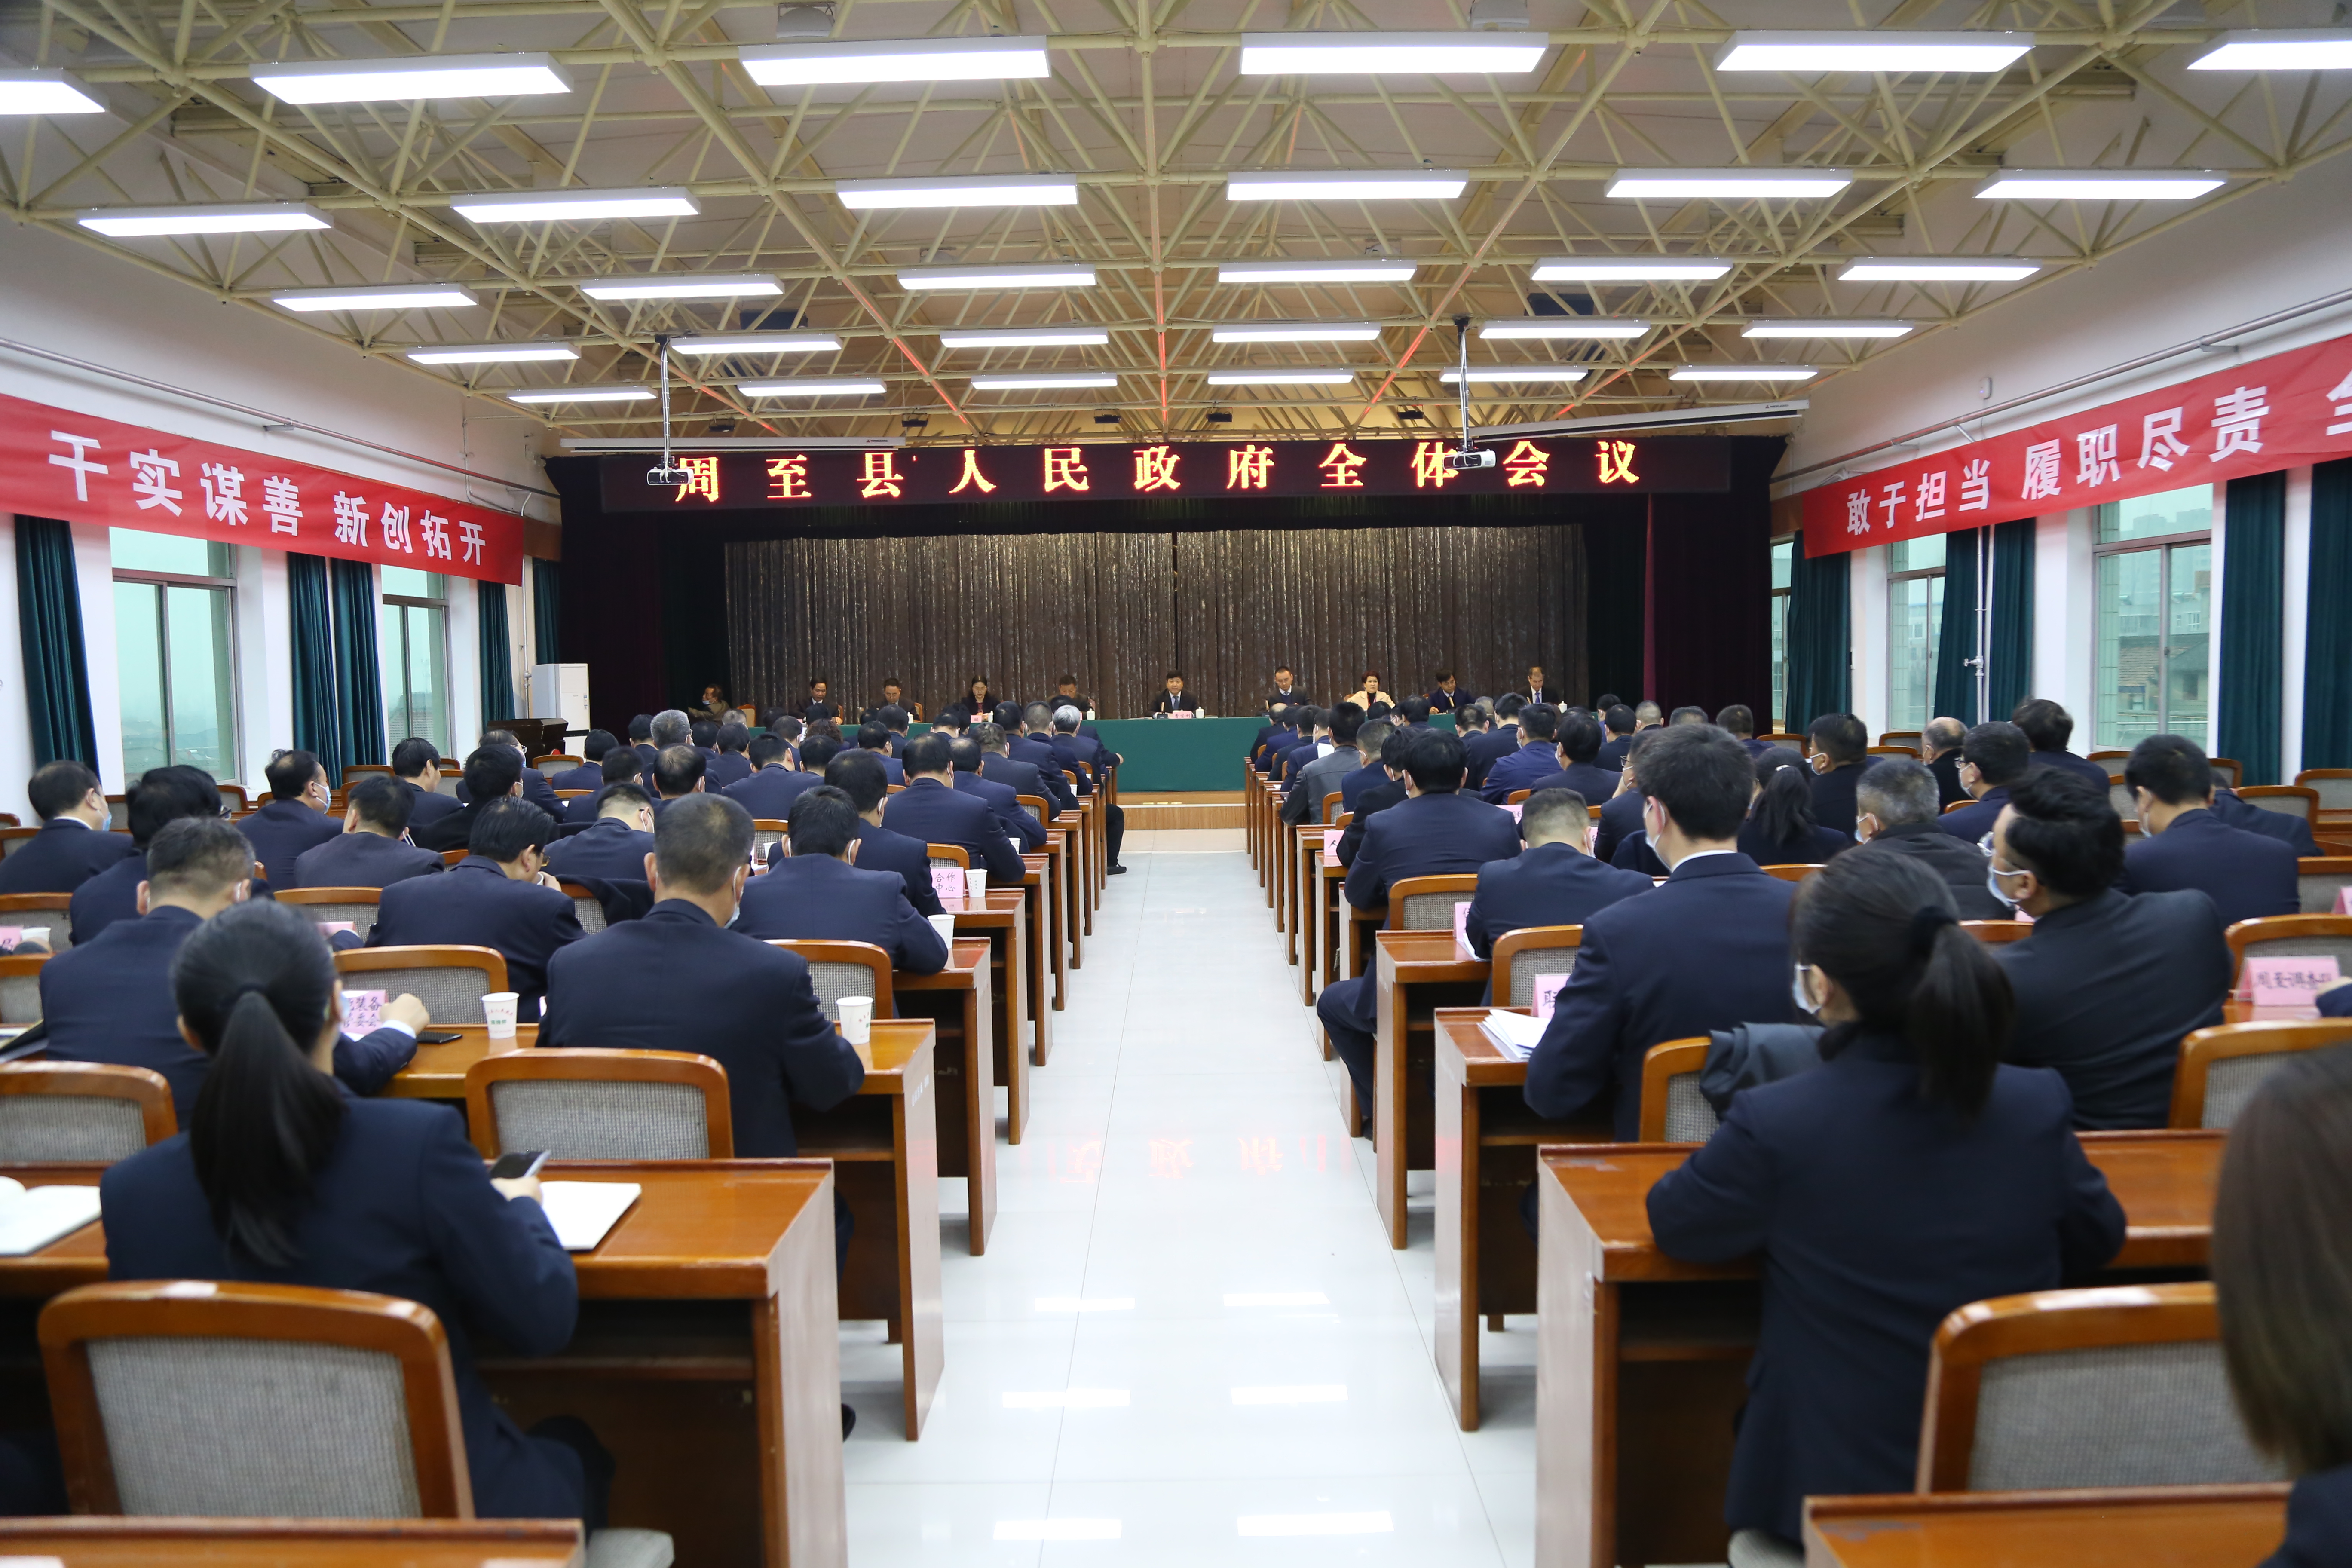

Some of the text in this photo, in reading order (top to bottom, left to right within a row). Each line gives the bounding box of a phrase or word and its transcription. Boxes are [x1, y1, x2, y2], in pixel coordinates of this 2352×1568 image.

[675, 441, 1639, 502] 周至县人民政府全体会议
[1847, 459, 1991, 536] 敢于担当
[2021, 386, 2270, 500] 履职尽责
